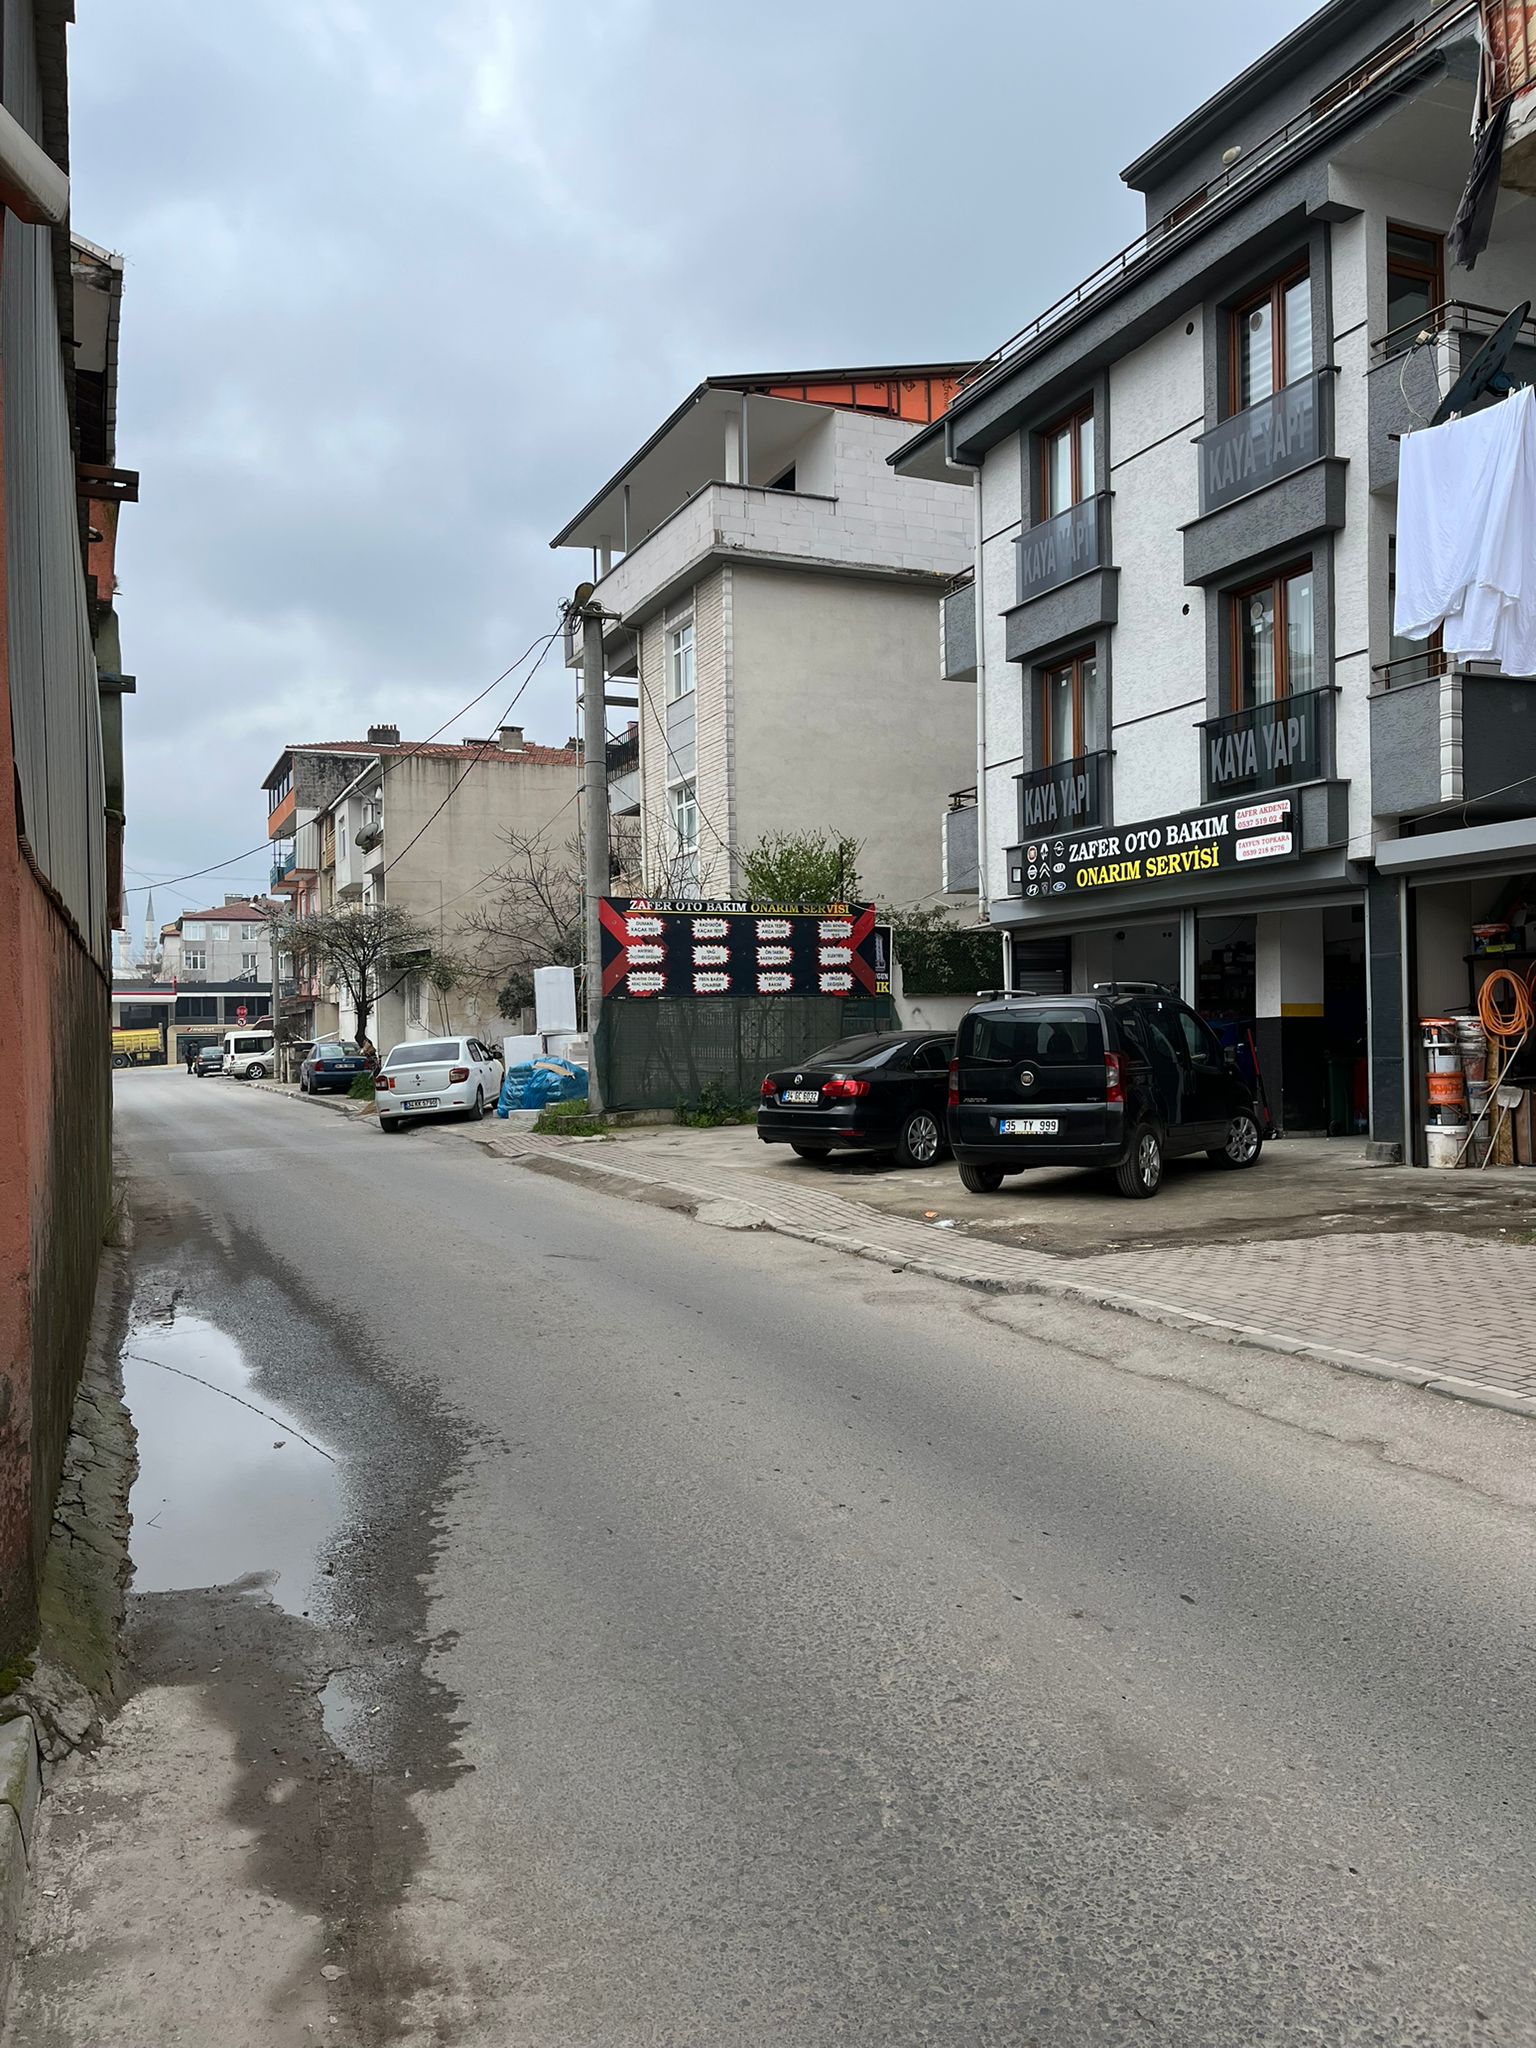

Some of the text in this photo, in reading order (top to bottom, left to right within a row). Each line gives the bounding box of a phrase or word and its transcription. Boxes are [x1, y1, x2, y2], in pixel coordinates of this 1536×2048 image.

[1209, 401, 1305, 494] KAYA YAPI
[1023, 535, 1057, 587] KAYA
[1211, 714, 1306, 783] KAYA YAPI
[1025, 773, 1090, 826] KAYA YAPI
[1237, 809, 1258, 819] ZAFER
[1238, 819, 1253, 828] 0537
[1255, 817, 1267, 825] 519
[1069, 814, 1229, 862] ZAFER OTO BAKIM
[1238, 835, 1290, 849] TAYFUN TOPKARA
[1076, 842, 1219, 887] ONARIM SERVİSİ
[629, 900, 850, 914] ZAFER OTO BAKIM ONARIM SERVİSİ
[787, 1091, 793, 1099] 34
[1005, 1120, 1057, 1131] 35 TY 999
